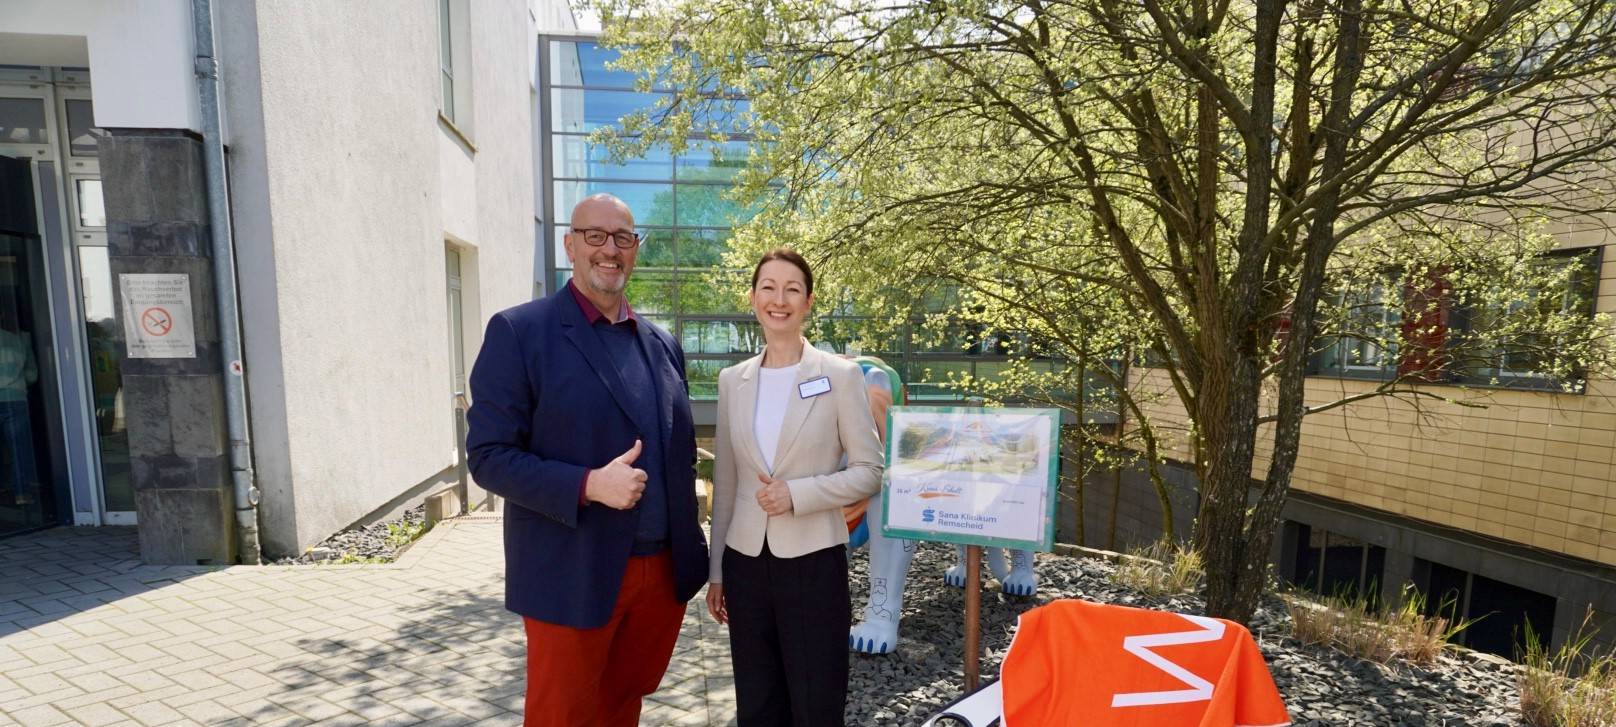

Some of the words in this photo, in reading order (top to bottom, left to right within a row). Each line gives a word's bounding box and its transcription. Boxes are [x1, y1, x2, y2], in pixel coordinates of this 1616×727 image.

[938, 510, 959, 520] Sana
[961, 513, 998, 523] Klinikum
[937, 518, 984, 530] Remscheid
